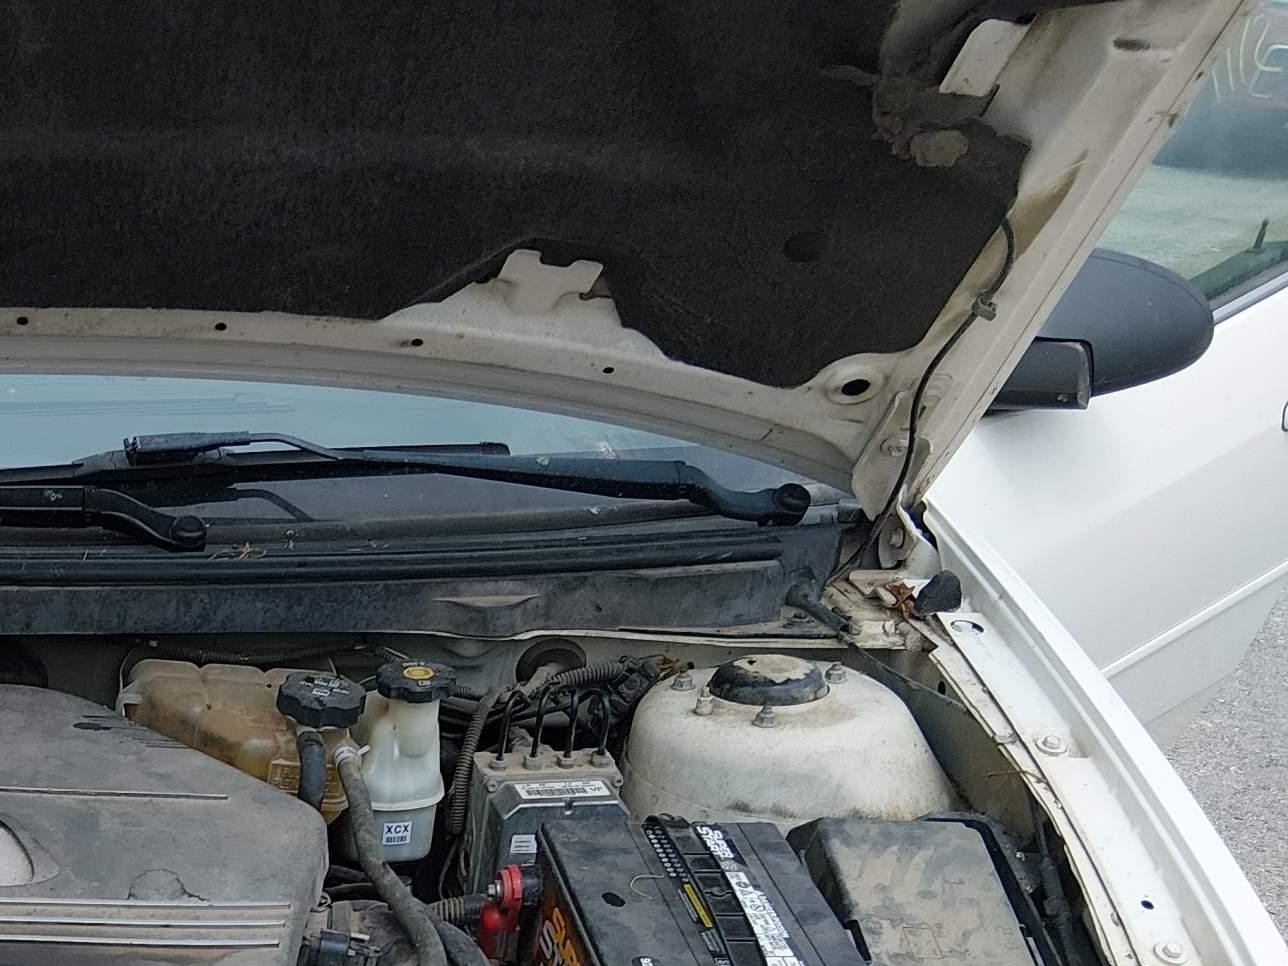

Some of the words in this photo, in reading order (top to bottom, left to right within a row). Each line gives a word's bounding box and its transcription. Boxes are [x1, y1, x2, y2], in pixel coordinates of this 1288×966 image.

[386, 823, 410, 835] XCX
[696, 826, 722, 856] START
[713, 830, 734, 860] SUPER
